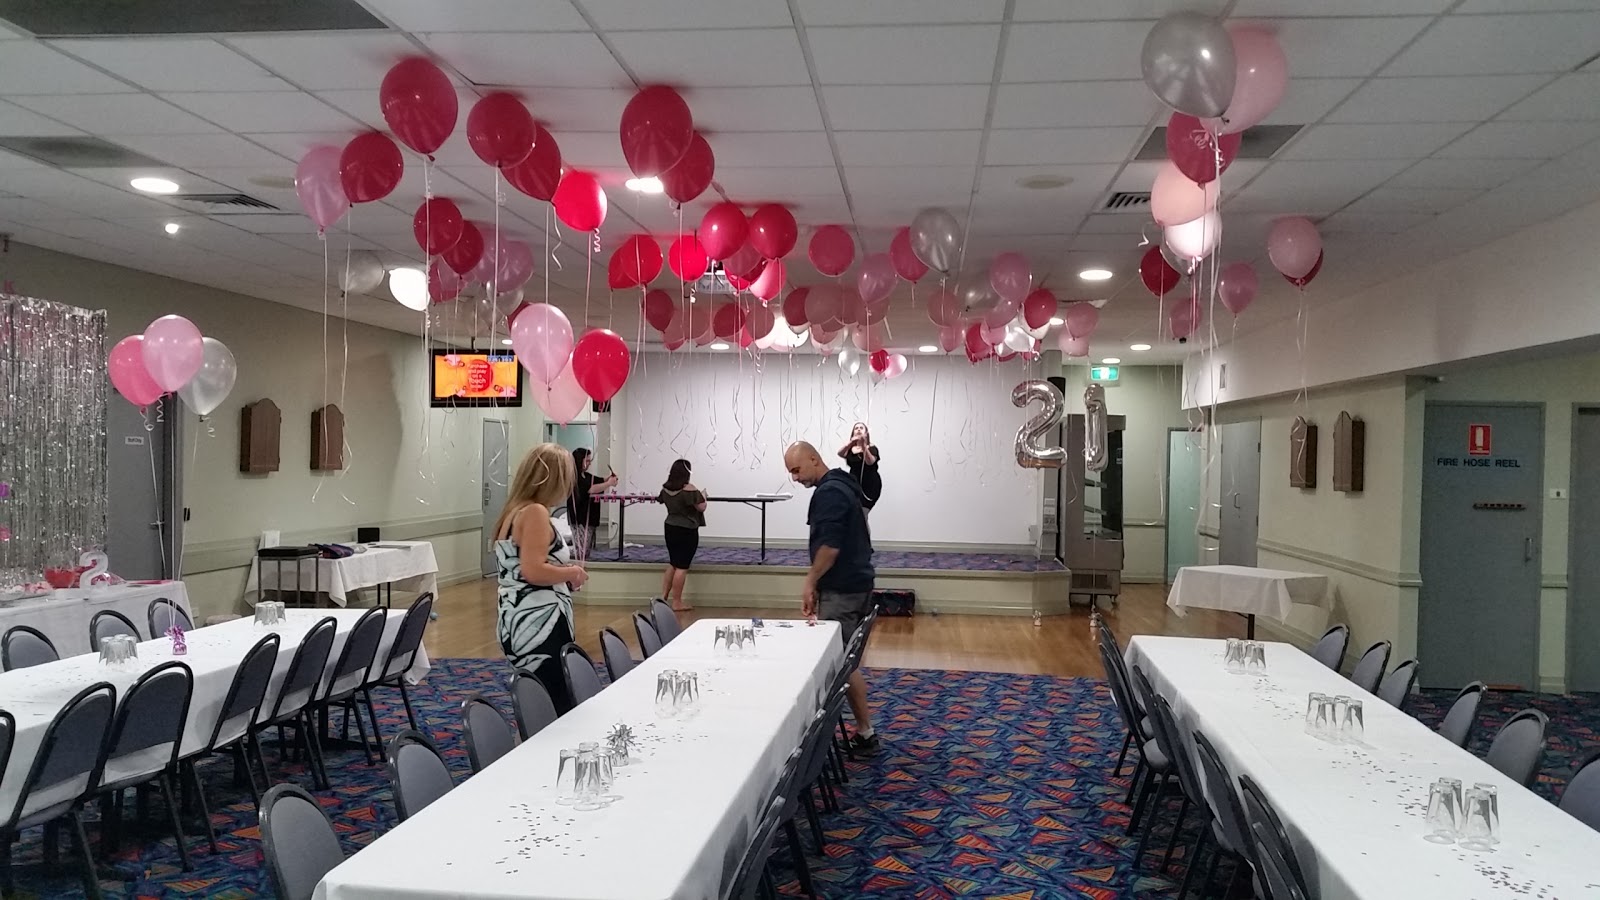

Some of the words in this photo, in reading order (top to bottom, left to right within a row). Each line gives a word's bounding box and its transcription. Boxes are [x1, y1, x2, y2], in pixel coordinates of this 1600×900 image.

[1437, 458, 1458, 466] FIRE
[1463, 458, 1490, 467] HOSE
[1495, 459, 1520, 468] REEL
